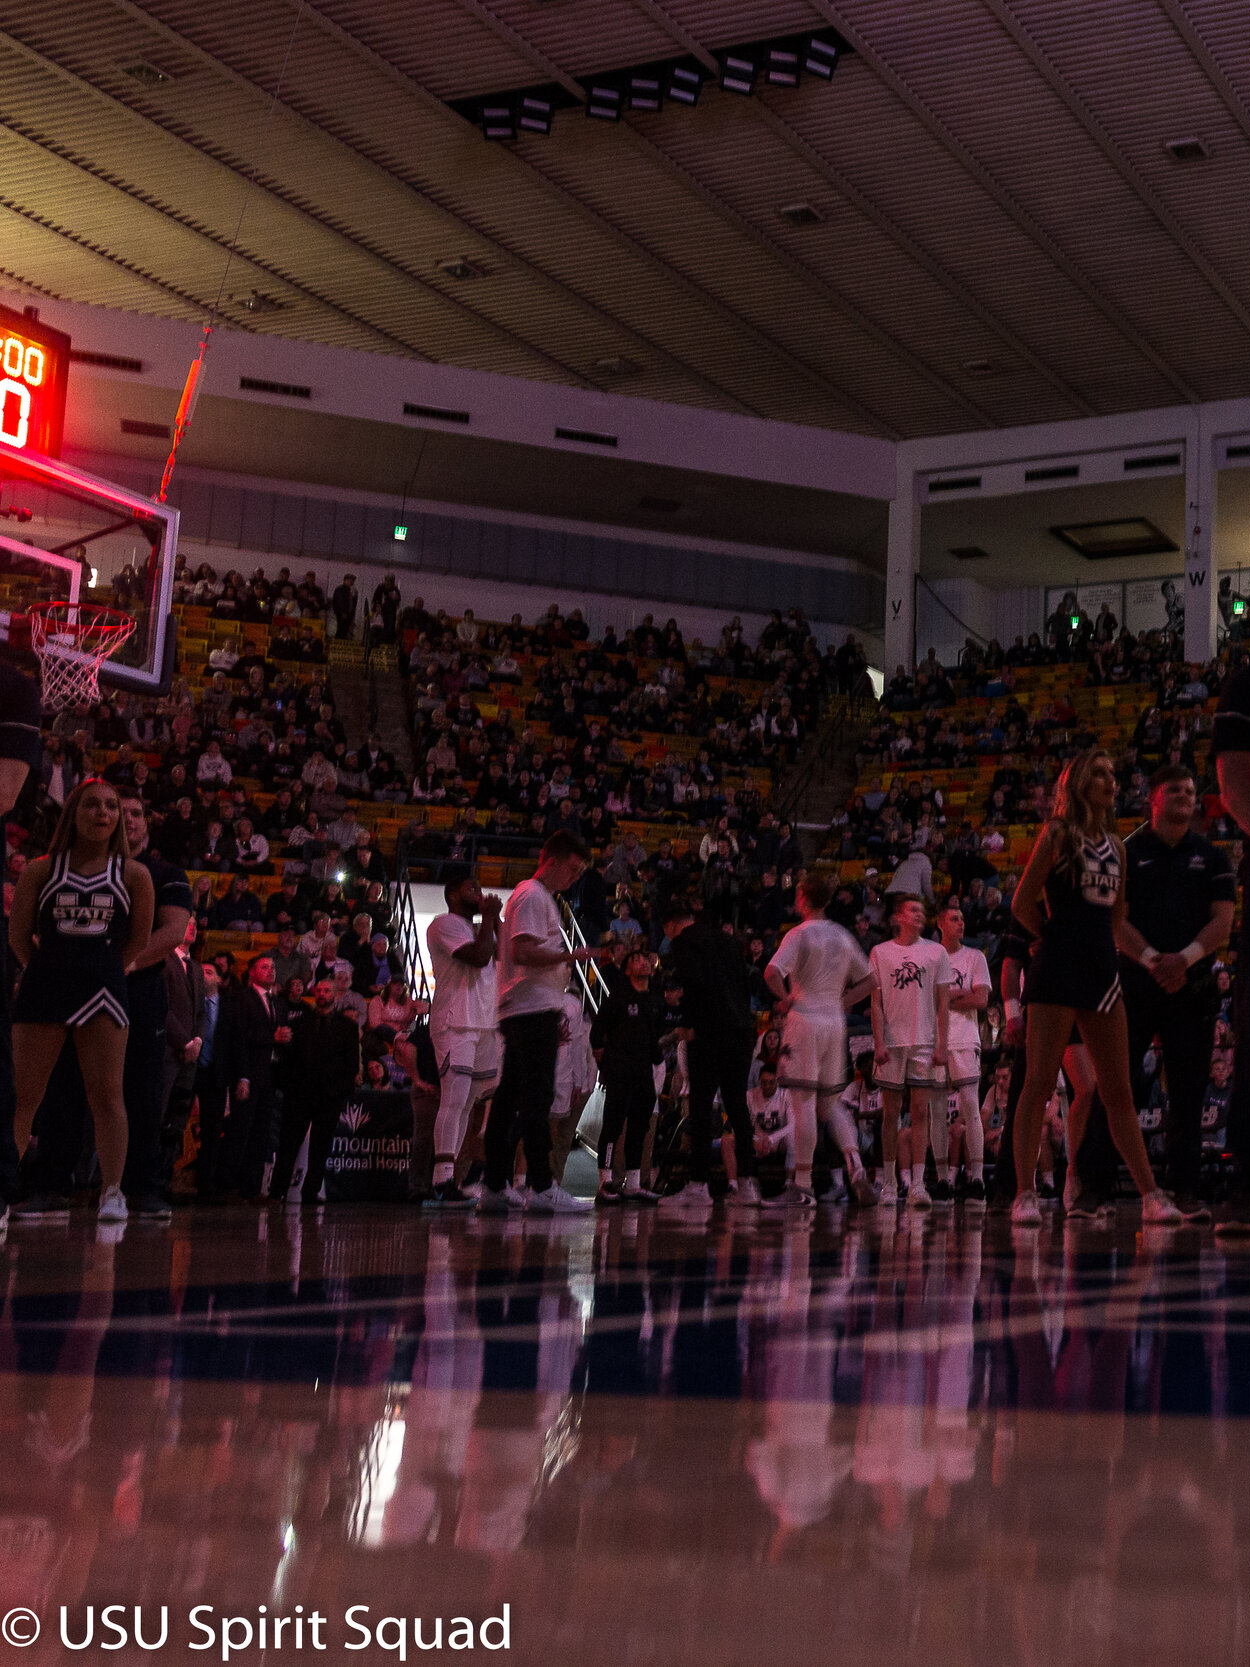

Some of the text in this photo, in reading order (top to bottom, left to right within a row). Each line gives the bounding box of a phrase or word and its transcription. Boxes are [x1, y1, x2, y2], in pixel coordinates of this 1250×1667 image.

[1189, 570, 1206, 587] W
[53, 907, 115, 920] STATE
[332, 1133, 411, 1153] mountain
[325, 1154, 411, 1174] egional Hospi
